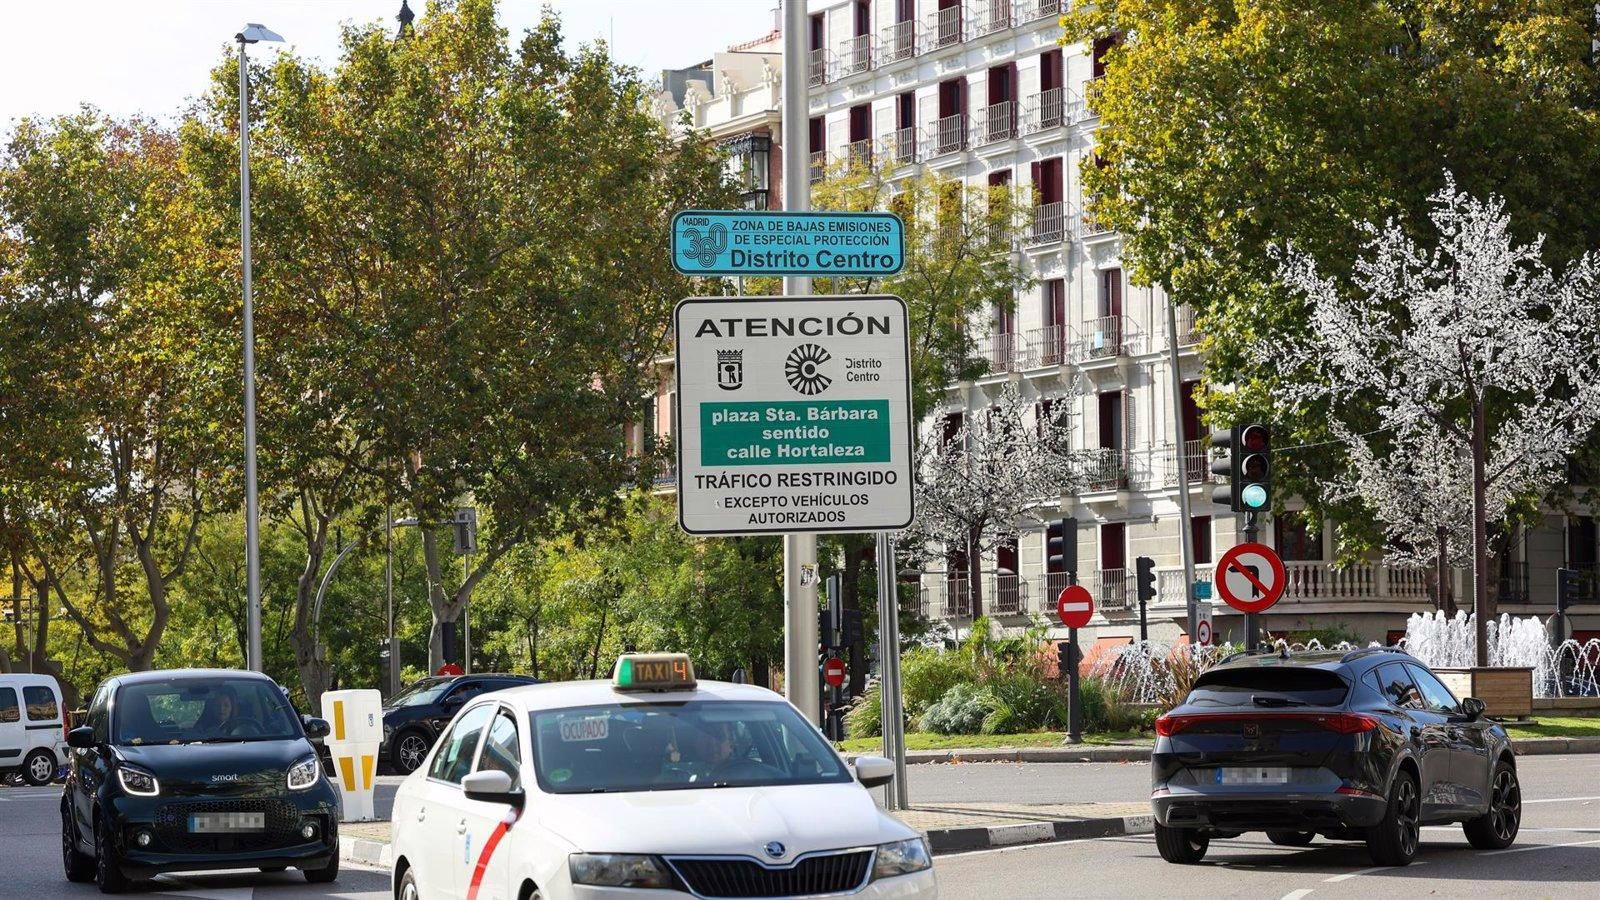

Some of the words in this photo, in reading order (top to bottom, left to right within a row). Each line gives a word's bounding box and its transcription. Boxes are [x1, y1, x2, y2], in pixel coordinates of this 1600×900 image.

[682, 217, 710, 226] MADRID
[732, 220, 765, 231] ZONA
[768, 221, 783, 231] DE
[787, 221, 825, 232] BAJAS
[828, 221, 891, 232] EMISIONES
[735, 234, 750, 245] DE
[754, 234, 810, 245] ESPECIAL
[814, 234, 889, 246] PROTECCIÓN
[731, 249, 810, 268] Distrito
[816, 249, 894, 268] Centro
[694, 312, 890, 338] ATENCIÓN
[846, 371, 880, 382] Centro
[712, 409, 760, 426] plaza
[765, 408, 801, 422] Sta.
[807, 406, 878, 421] Bárbara
[762, 425, 830, 440] sentido
[727, 444, 772, 459] calle
[777, 443, 865, 459] Hortaleza
[694, 471, 772, 490] TRÁFICO
[777, 470, 898, 488] RESTRINGIDO
[724, 496, 788, 508] EXCEPTO
[791, 492, 869, 507] VEHÍCULOS
[748, 510, 846, 525] AUTORIZADOS
[636, 663, 669, 680] TAXI
[674, 662, 687, 680] 4
[562, 720, 607, 740] OCUPADO
